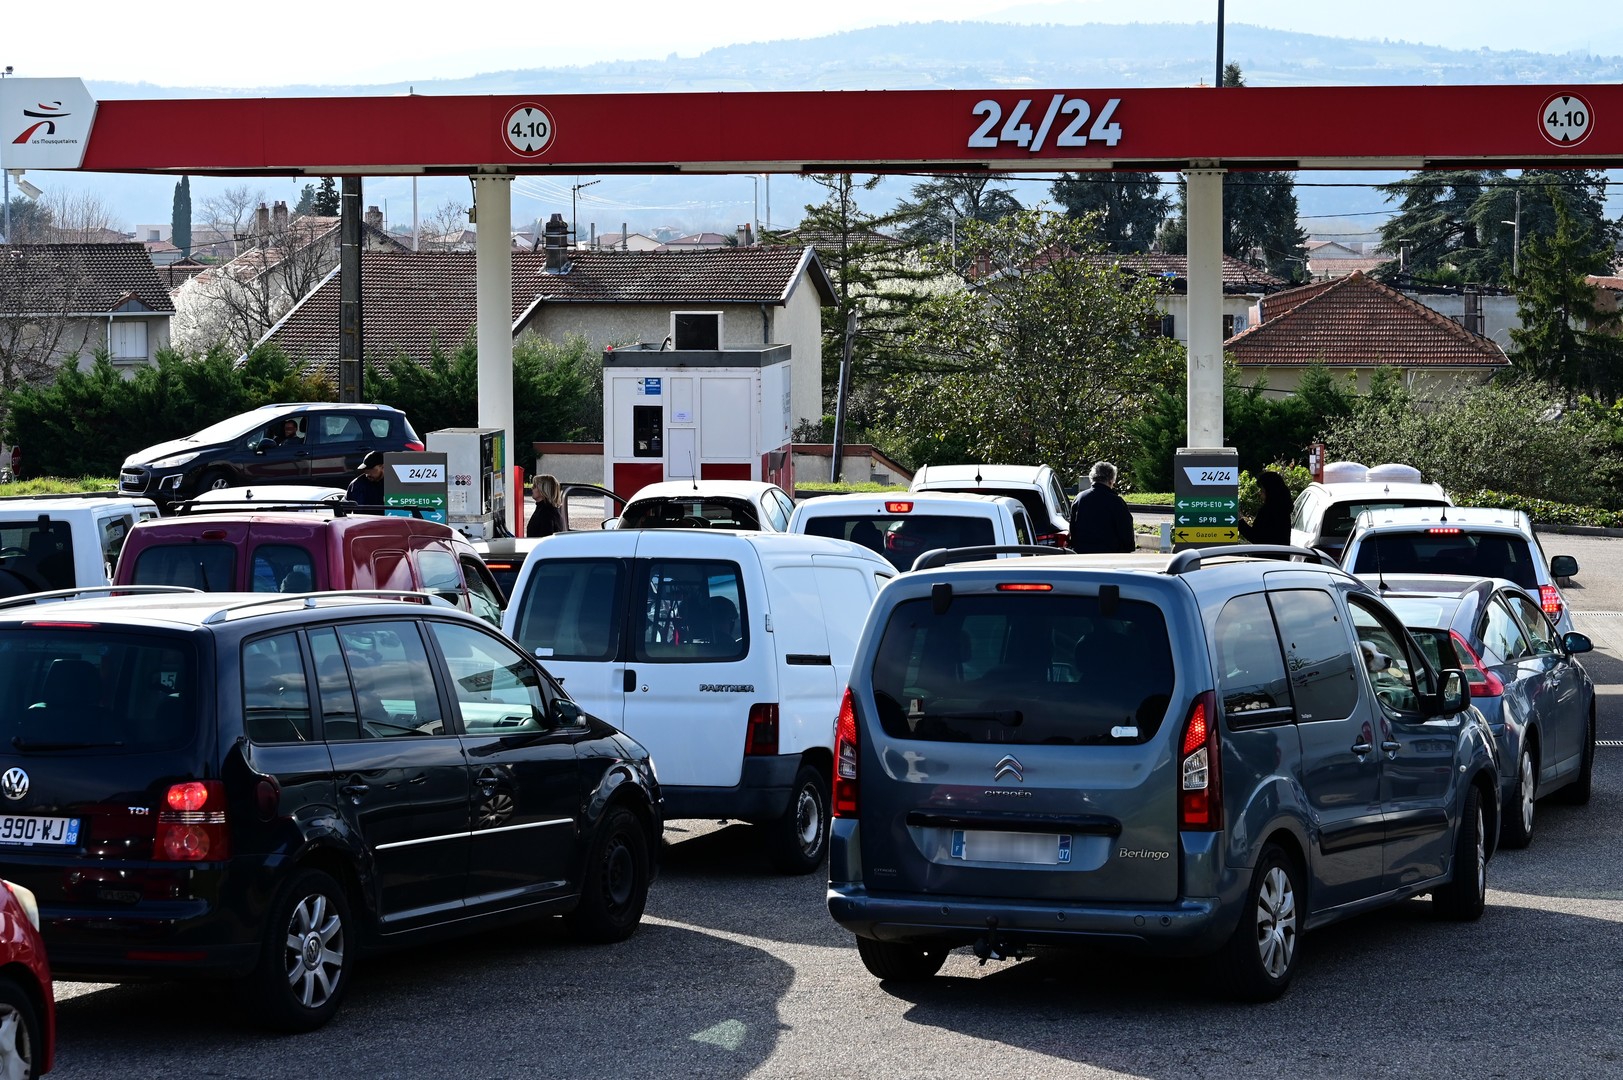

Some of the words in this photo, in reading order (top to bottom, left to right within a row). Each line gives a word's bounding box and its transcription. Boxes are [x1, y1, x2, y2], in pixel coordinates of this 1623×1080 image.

[967, 94, 1122, 152] 24/24
[1547, 111, 1585, 127] 4.10
[511, 122, 547, 137] 4.10
[409, 468, 438, 479] 24/24
[1201, 470, 1230, 482] 24/24
[699, 684, 754, 692] PARTNER
[128, 806, 149, 816] TDI
[66, 832, 77, 842] 38
[1059, 849, 1070, 860] 07
[1119, 848, 1170, 860] Berlingo
